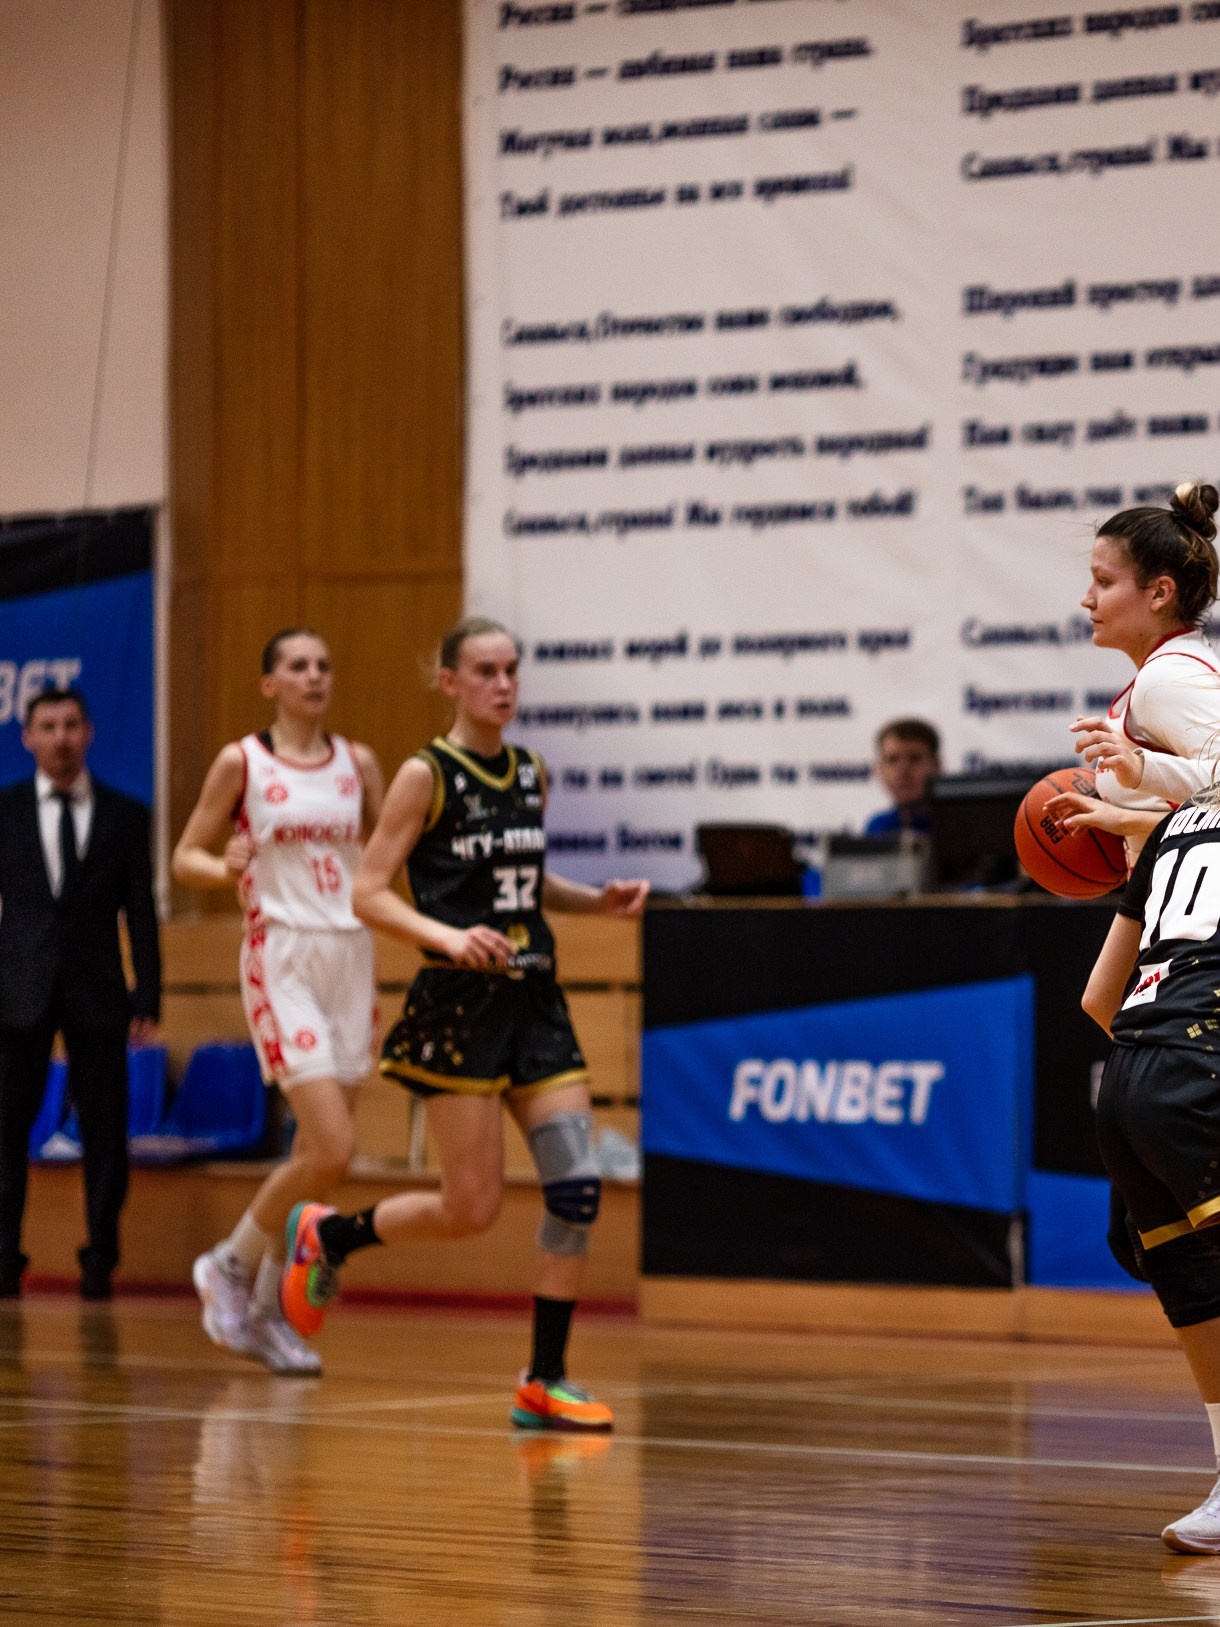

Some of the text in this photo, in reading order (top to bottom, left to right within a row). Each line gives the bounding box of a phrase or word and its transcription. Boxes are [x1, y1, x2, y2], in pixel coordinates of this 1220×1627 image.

[1040, 815, 1065, 845] FIBA
[311, 855, 342, 895] 15
[493, 865, 540, 912] 32
[729, 1059, 945, 1124] FONBET
